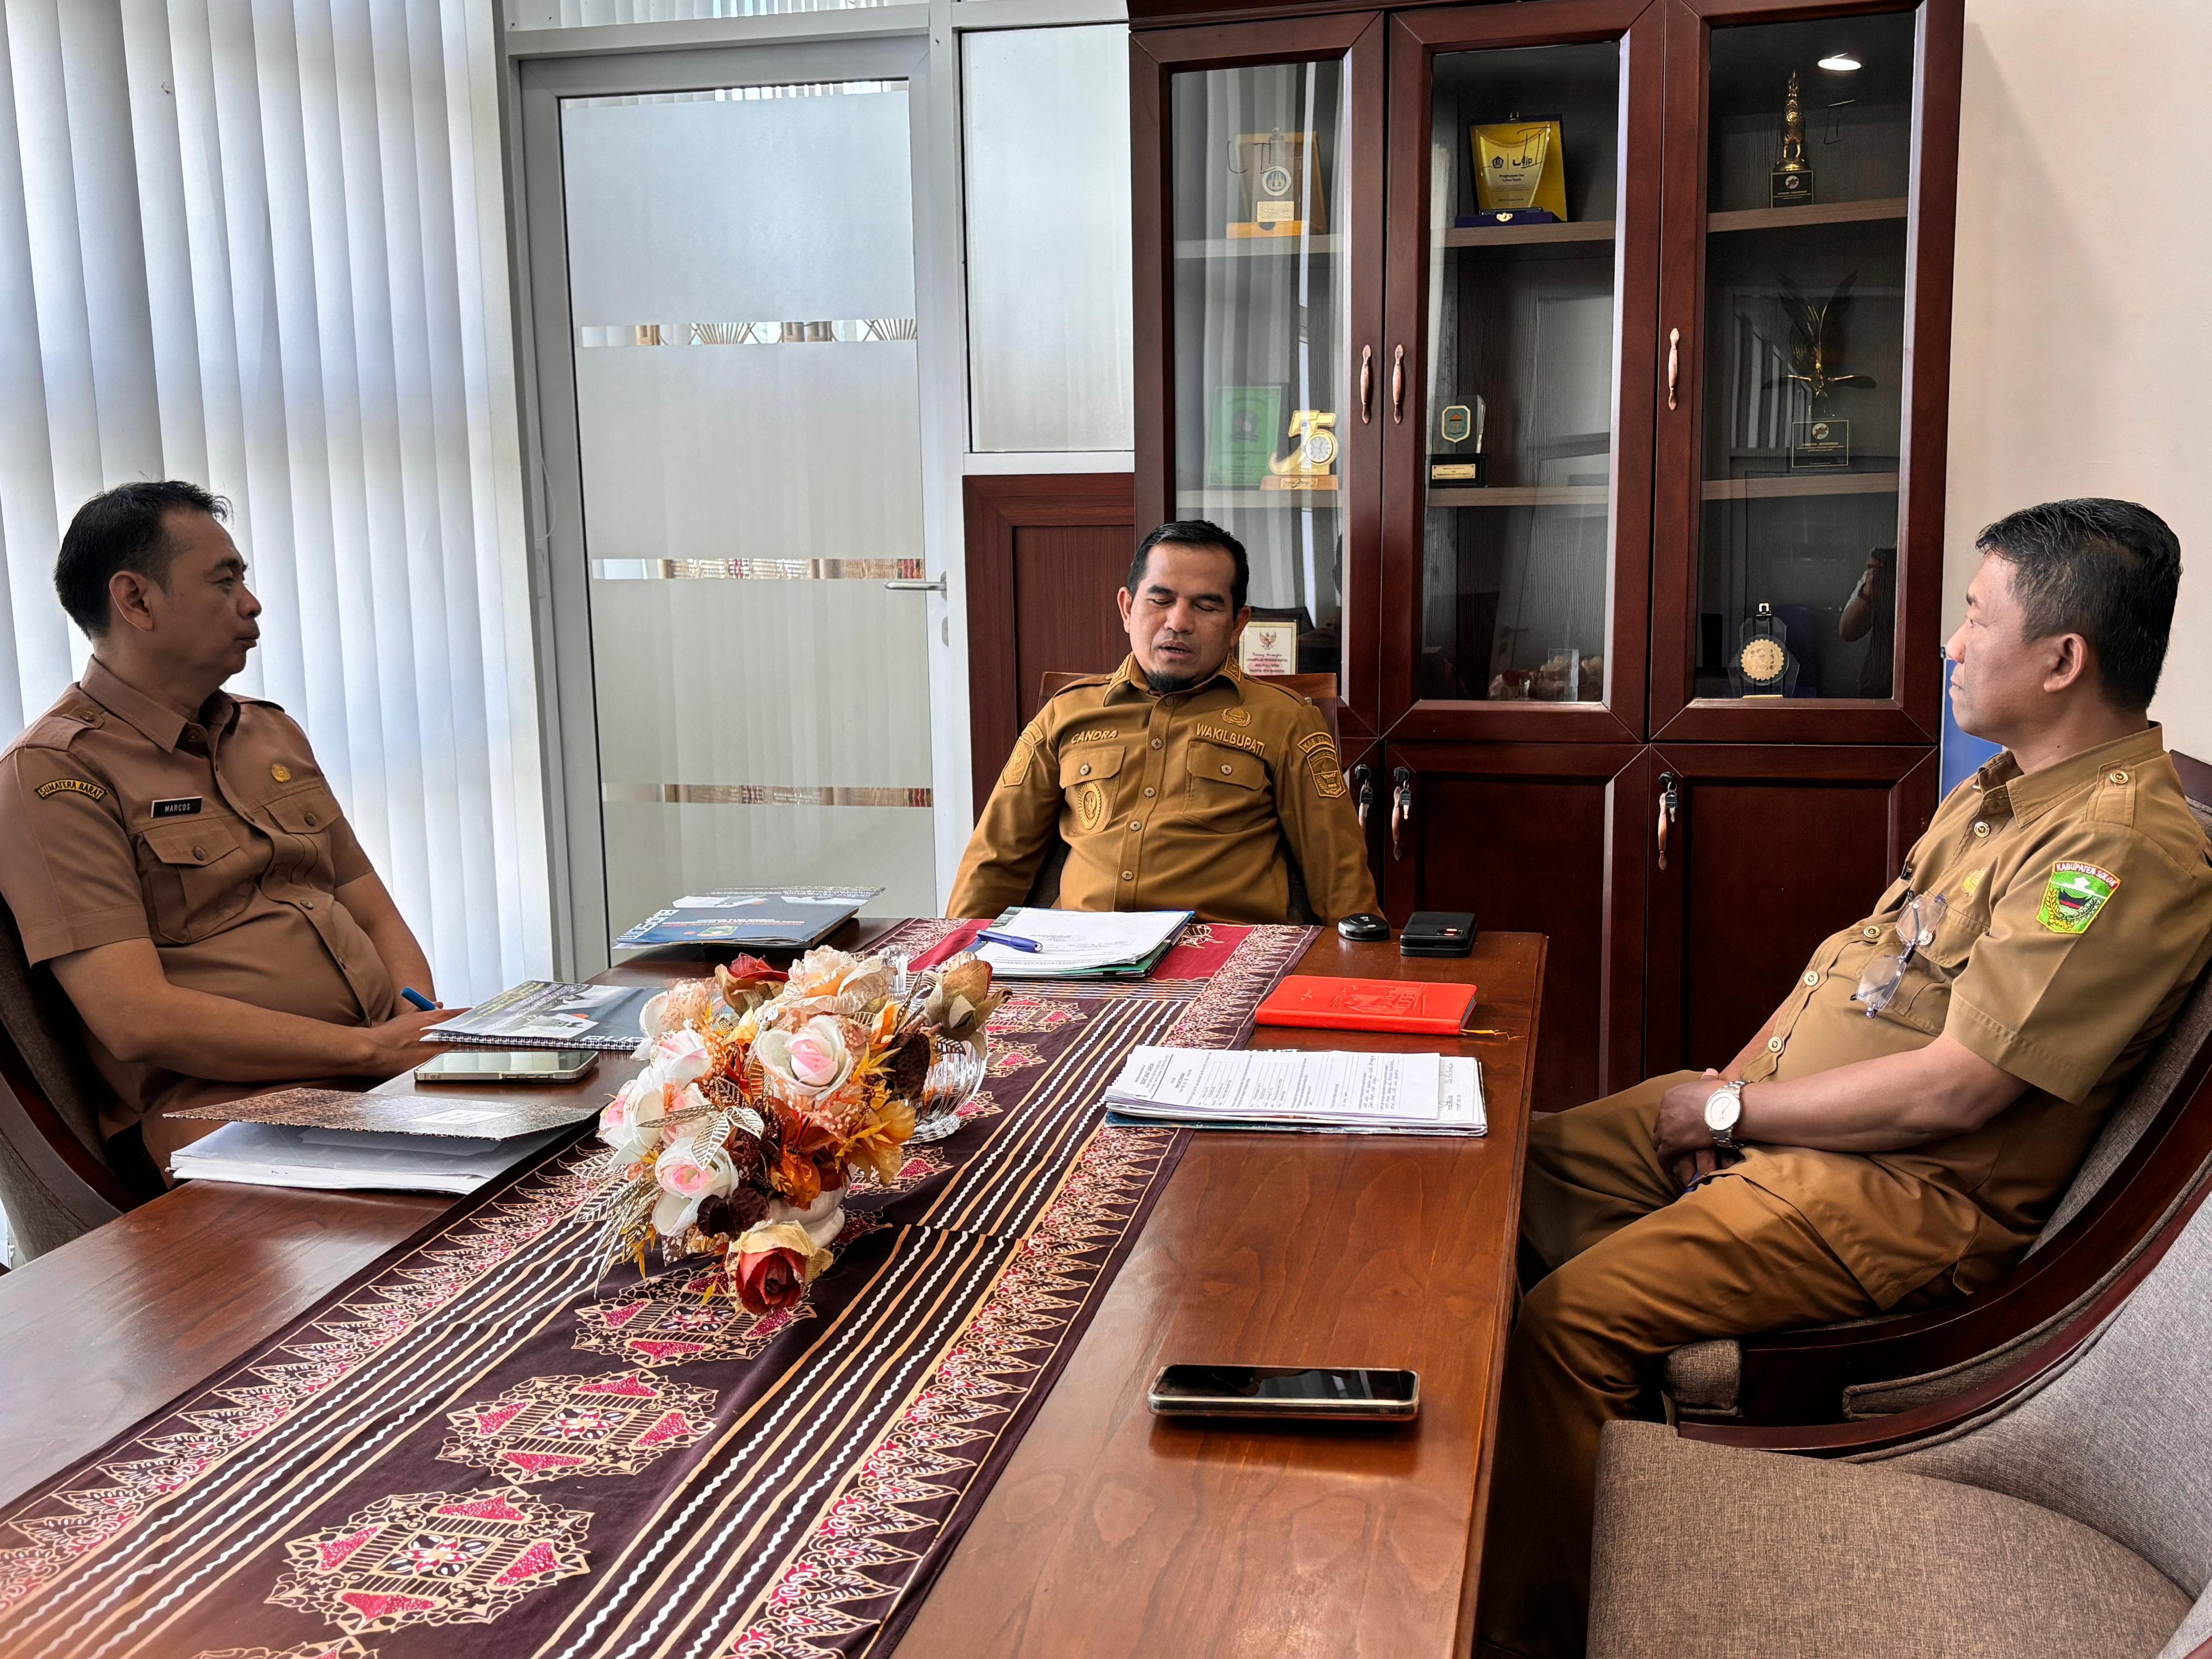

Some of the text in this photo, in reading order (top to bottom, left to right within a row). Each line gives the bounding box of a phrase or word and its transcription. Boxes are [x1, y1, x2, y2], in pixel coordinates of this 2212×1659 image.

[1071, 729, 1118, 744] CANDRA
[40, 781, 103, 799] SUMATERA BARAT
[2056, 863, 2118, 887] KABUPATEN SOLOK
